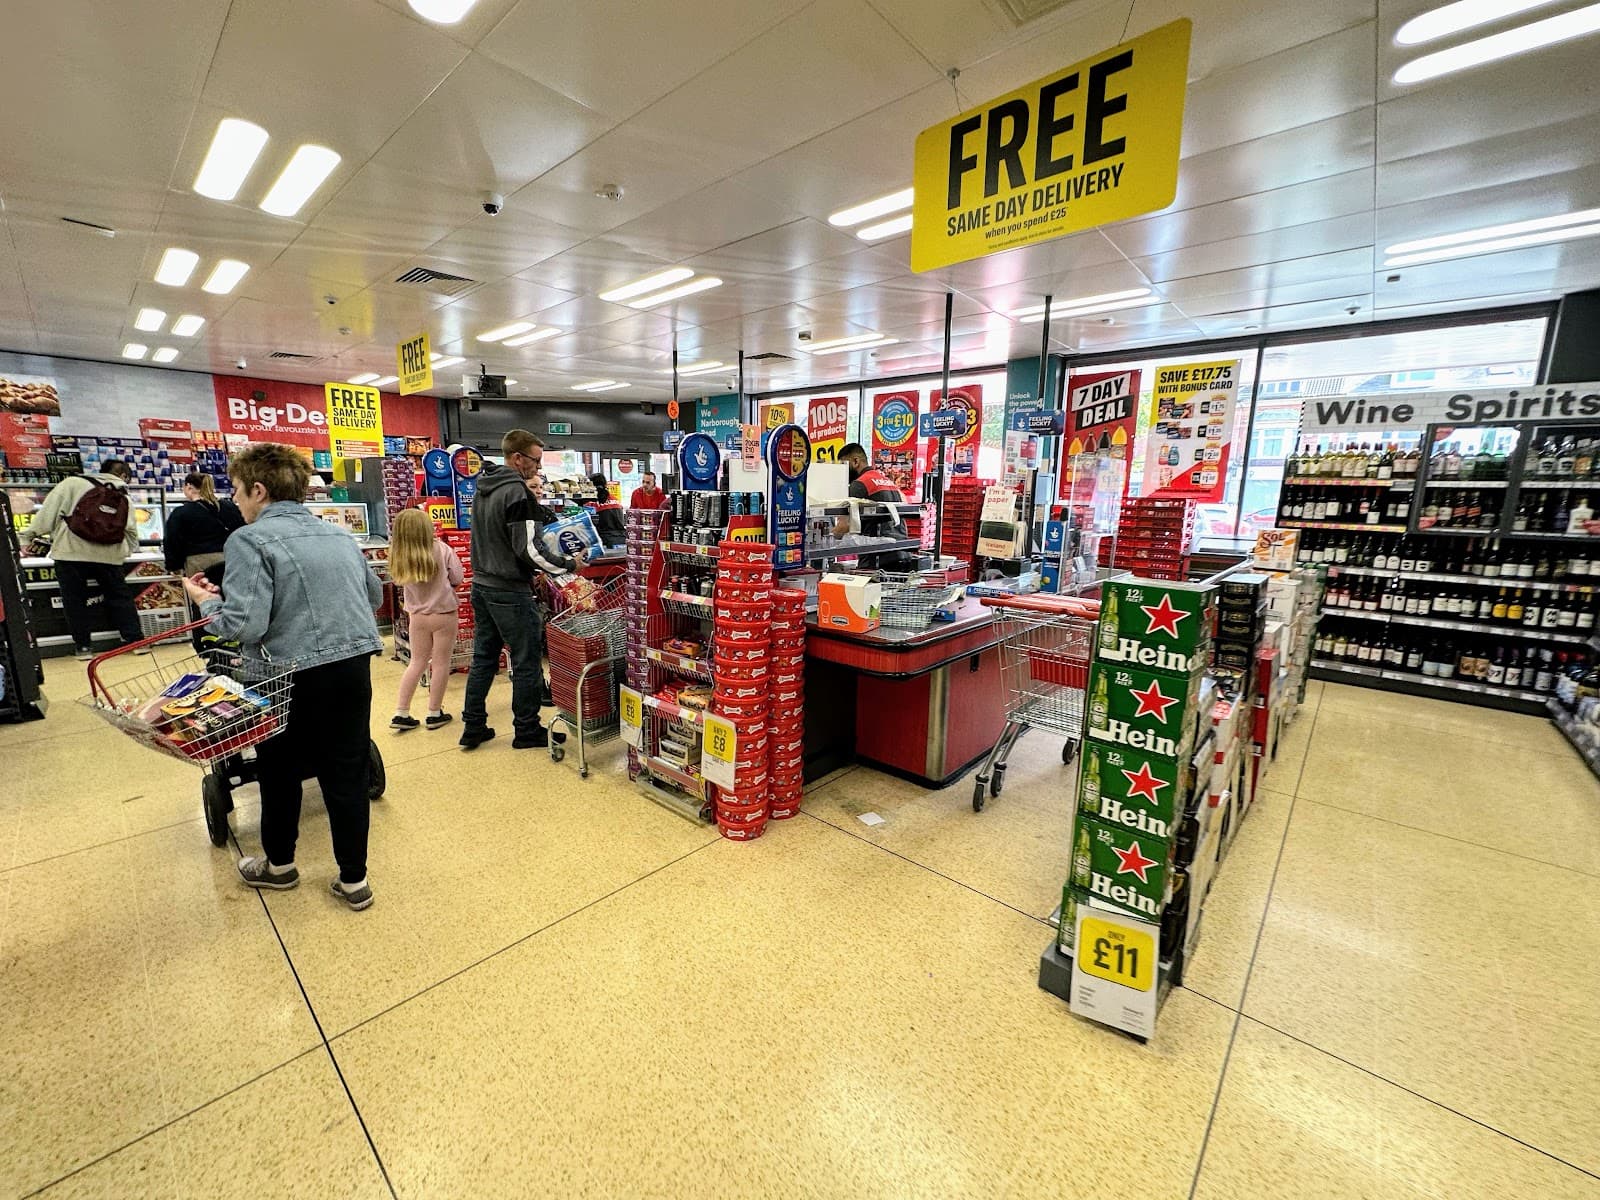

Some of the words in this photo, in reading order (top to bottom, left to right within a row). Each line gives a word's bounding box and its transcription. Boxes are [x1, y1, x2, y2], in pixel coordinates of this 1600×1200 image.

[947, 49, 1134, 211] FREE
[947, 205, 991, 237] SAME
[995, 193, 1029, 223] DAY
[1032, 162, 1125, 212] DELIVERY
[985, 228, 1006, 239] when
[1007, 223, 1022, 235] you
[1023, 212, 1048, 229] spend
[402, 337, 426, 375] FREE
[1160, 370, 1189, 383] SAVE
[1192, 366, 1231, 381] £17.75
[1079, 388, 1089, 406] 7
[1092, 377, 1124, 401] DAY
[1158, 384, 1179, 393] WITH
[1180, 382, 1207, 392] BONUS
[1209, 380, 1233, 390] CARD
[330, 388, 376, 410] FREE
[940, 398, 947, 410] 3
[1037, 397, 1044, 409] 4
[1315, 399, 1414, 425] Wine
[1445, 388, 1600, 423] Spirits
[228, 397, 329, 426] Big-De
[333, 408, 358, 418] SAME
[361, 410, 376, 419] DAY
[701, 409, 711, 417] We
[770, 408, 786, 423] 10%
[809, 401, 847, 428] 100s
[1082, 400, 1126, 427] DEAL
[333, 417, 376, 429] DELIVERY
[701, 416, 739, 428] Narborough
[877, 415, 884, 429] 3
[894, 413, 914, 428] £10
[274, 425, 316, 434] favourite
[809, 431, 817, 439] of
[817, 424, 846, 440] products
[777, 509, 801, 517] FEELING
[1126, 588, 1140, 597] 12
[1115, 671, 1129, 681] 12
[626, 704, 635, 719] £8
[713, 735, 726, 753] £8
[1107, 751, 1120, 761] 12
[1097, 828, 1111, 838] 12
[1093, 937, 1138, 979] £11
